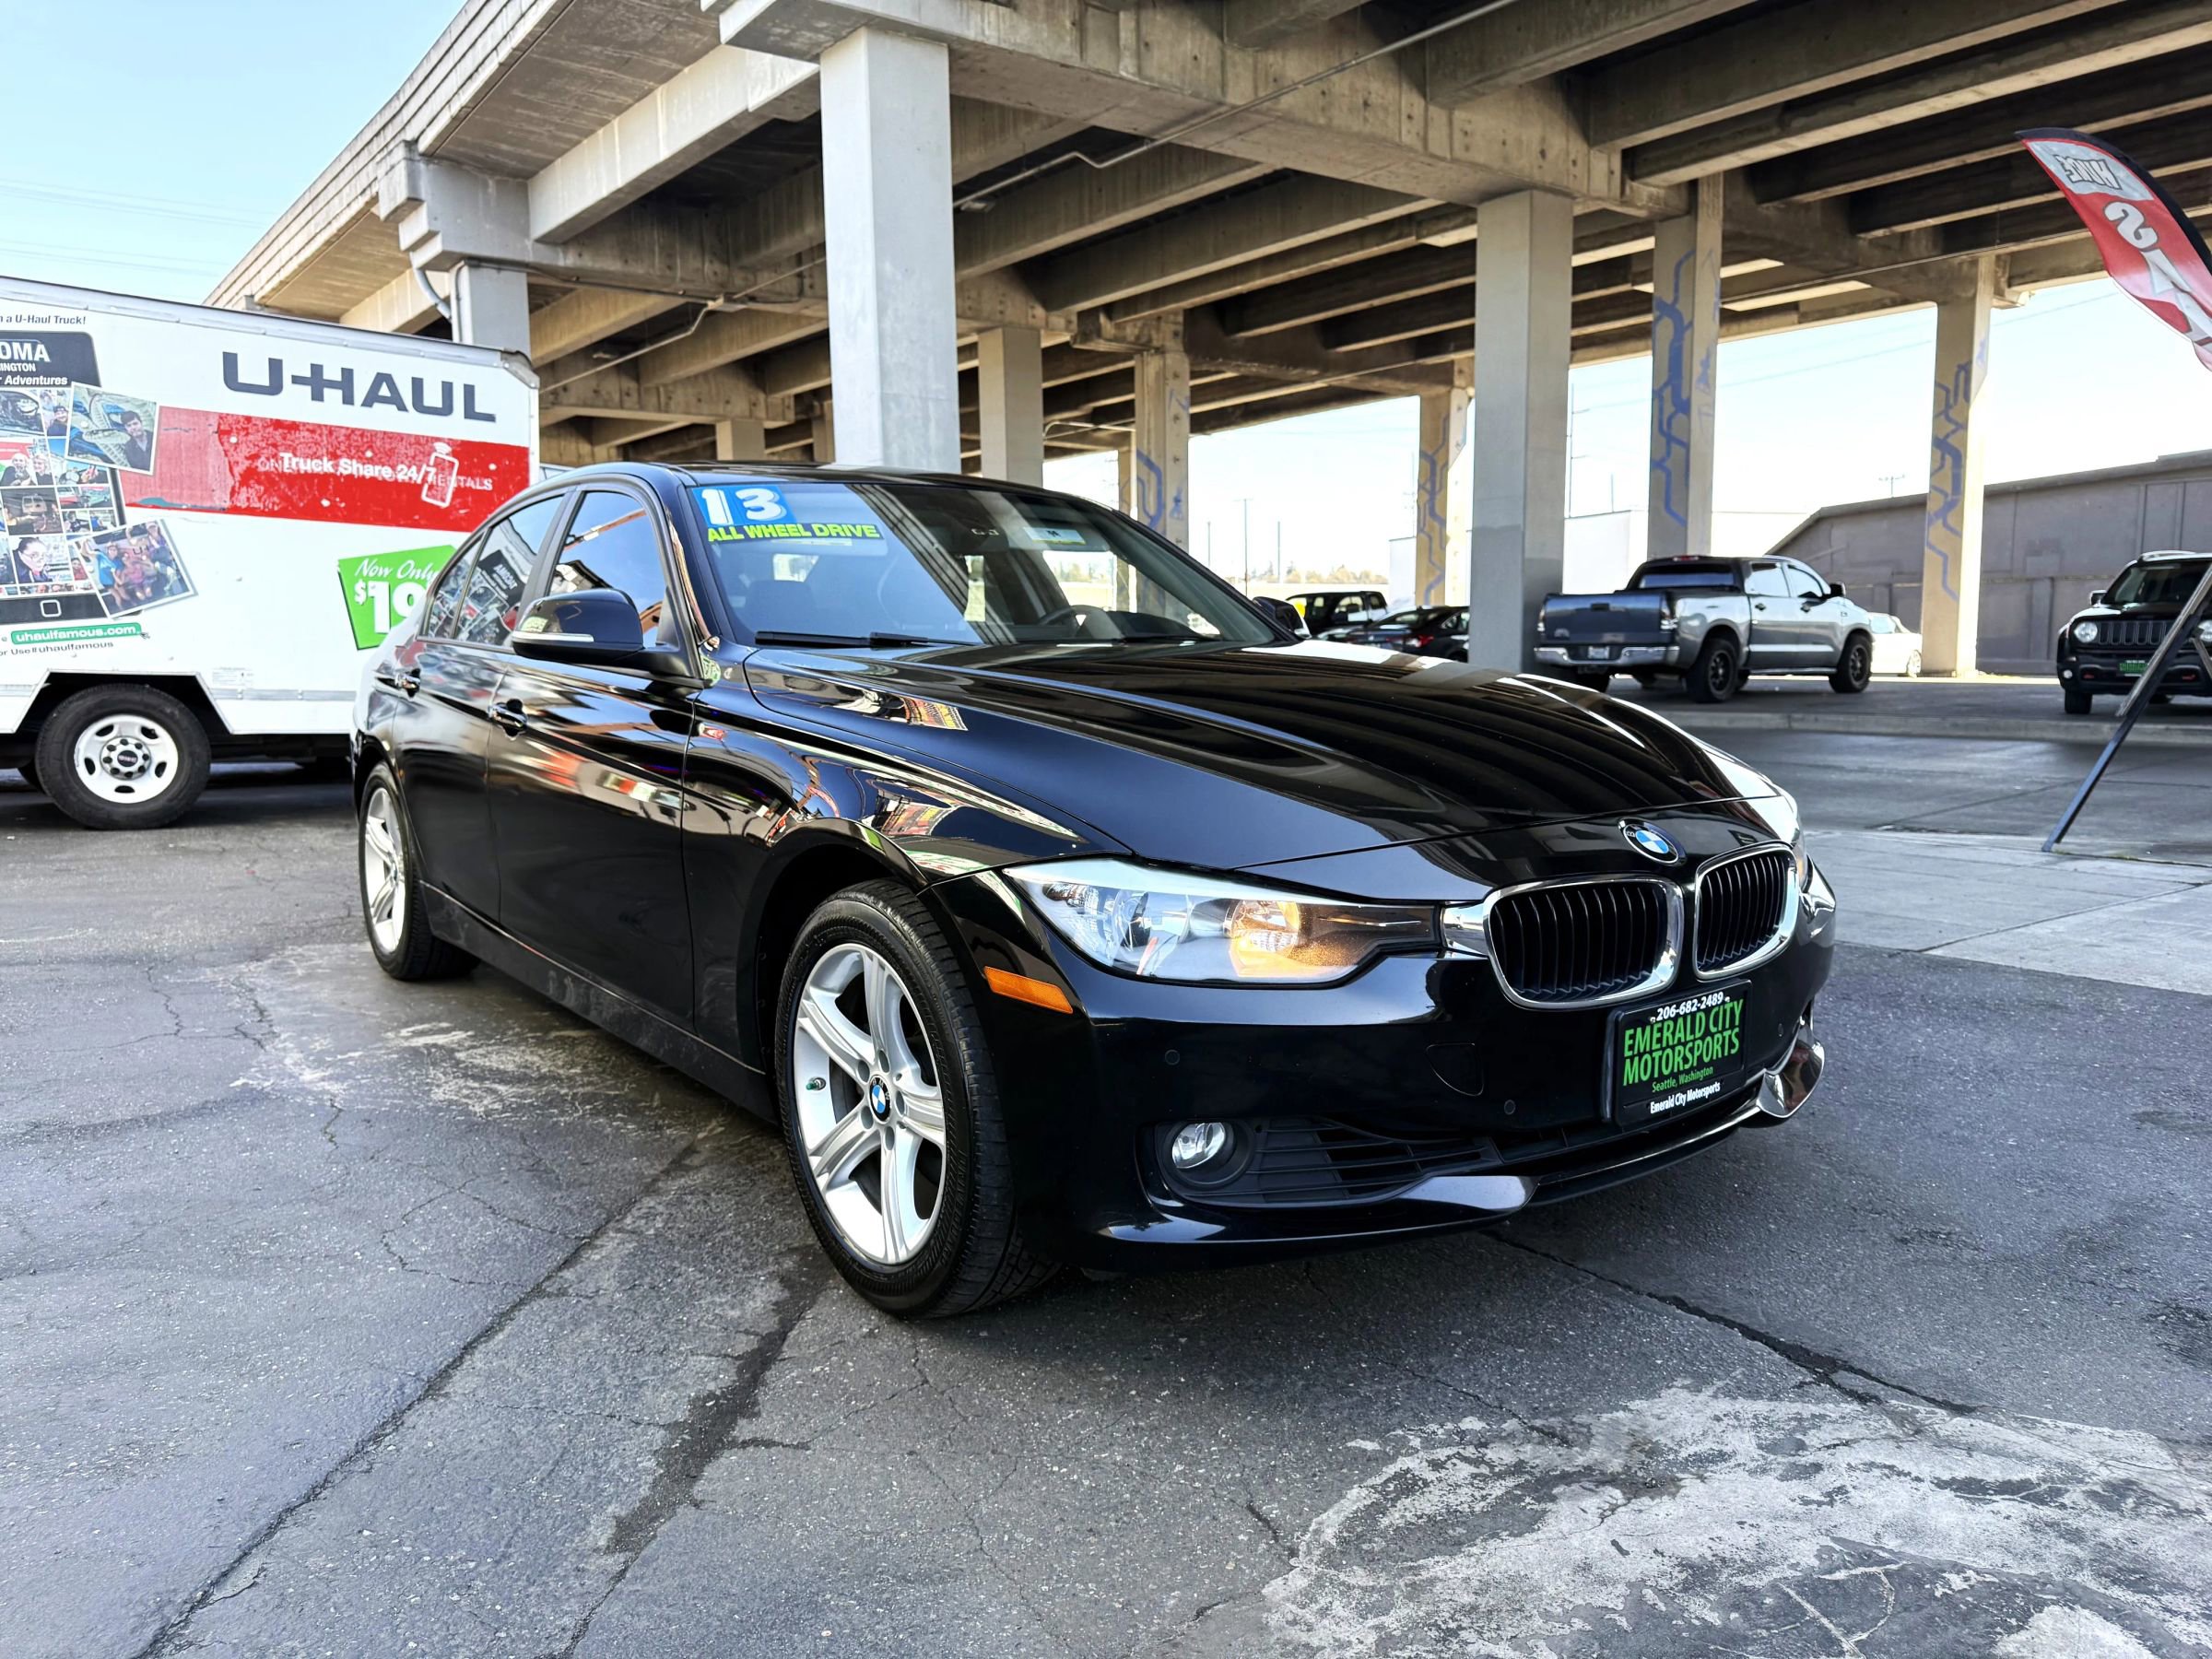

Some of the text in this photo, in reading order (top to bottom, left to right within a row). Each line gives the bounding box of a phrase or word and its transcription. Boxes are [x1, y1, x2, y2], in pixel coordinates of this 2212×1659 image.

[15, 313, 51, 324] U-Haul
[53, 315, 87, 325] Truck!
[4, 374, 68, 385] Adventures
[222, 351, 496, 423] U-HAUL
[279, 452, 437, 485] Truck Share 24/7
[701, 488, 786, 526] 13
[708, 524, 880, 542] ALL WHEEL DRIVE
[355, 559, 393, 578] Now
[16, 625, 136, 642] uhaulfamous.com
[1656, 992, 1724, 1020] 206-682-2489
[1624, 999, 1744, 1057] EMERALD CITY
[1623, 1028, 1740, 1087] MOTORSPORTS
[1652, 1066, 1713, 1093] Seattle, Washington
[1650, 1081, 1721, 1114] Emerald City Motorsports
